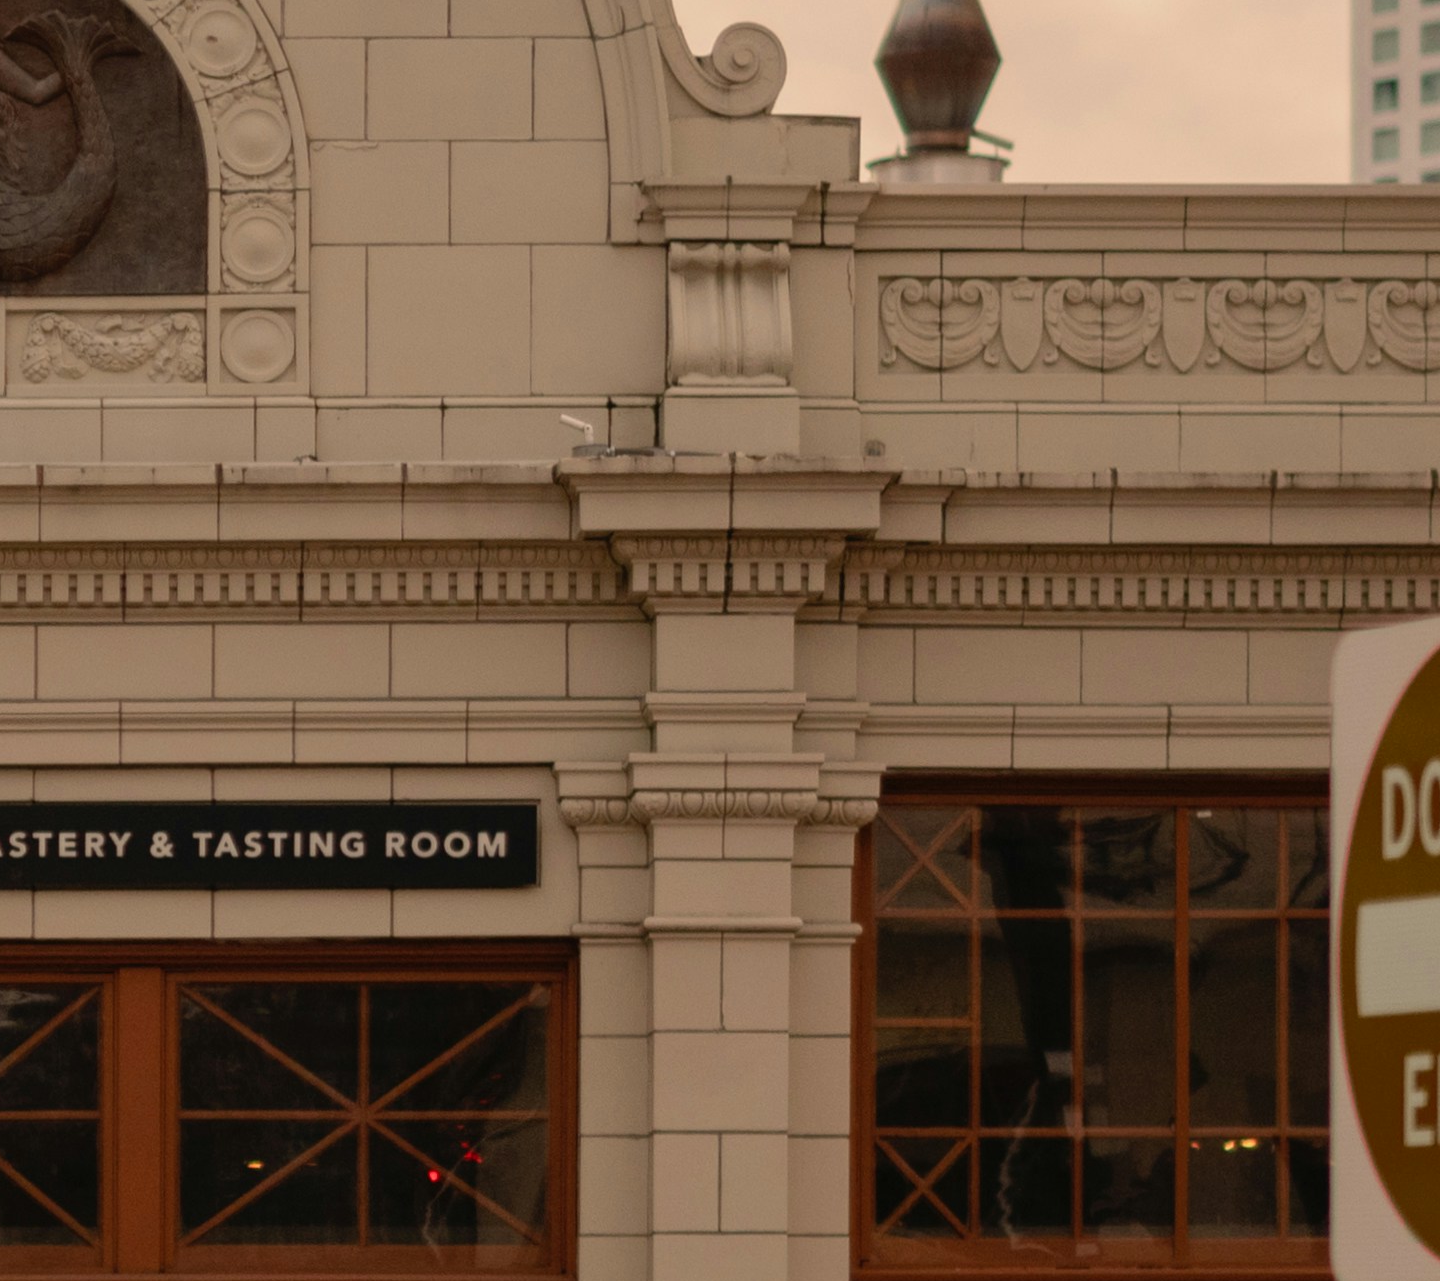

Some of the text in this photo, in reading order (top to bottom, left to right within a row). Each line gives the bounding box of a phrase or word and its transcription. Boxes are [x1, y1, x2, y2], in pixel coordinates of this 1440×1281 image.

[148, 830, 175, 859] &
[192, 830, 367, 859] TASTING
[385, 830, 508, 859] ROOM
